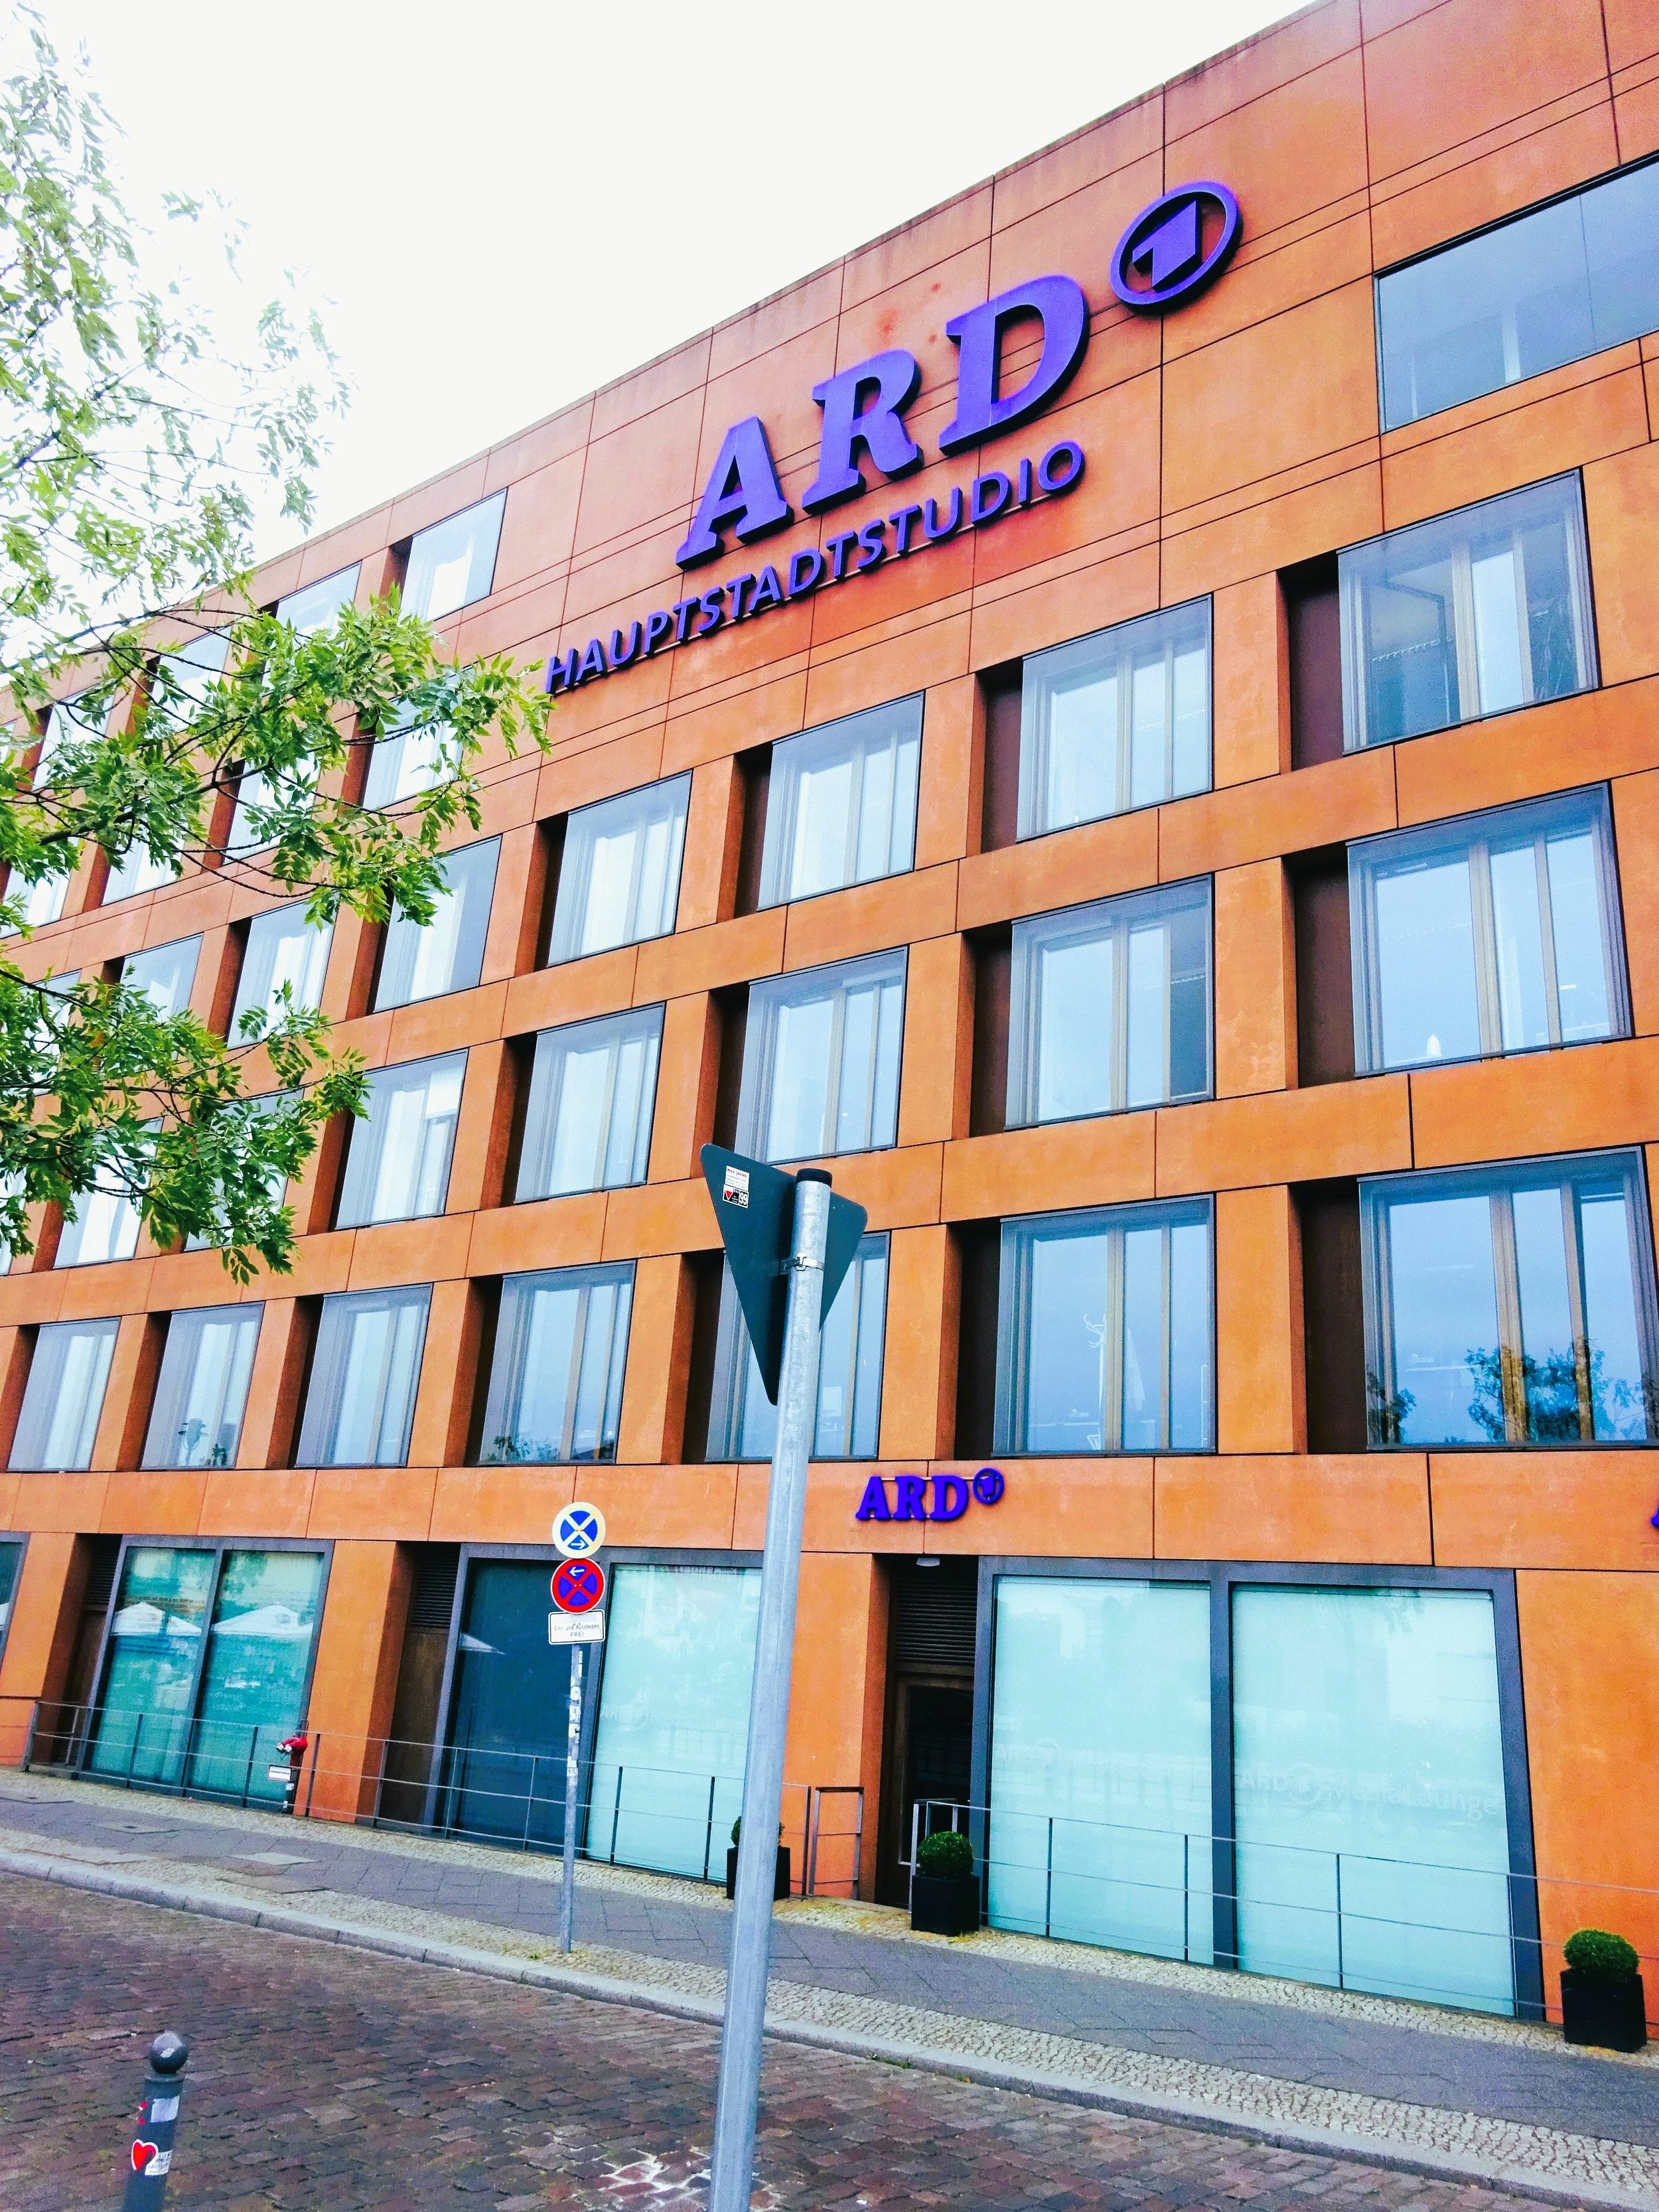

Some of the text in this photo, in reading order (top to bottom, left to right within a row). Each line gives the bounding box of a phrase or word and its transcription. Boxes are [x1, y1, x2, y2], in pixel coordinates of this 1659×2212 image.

[674, 274, 1090, 571] ARD
[545, 440, 1086, 696] HAUPTSTADTSTUDIO
[739, 1192, 748, 1206] 99
[855, 1475, 970, 1521] ARD
